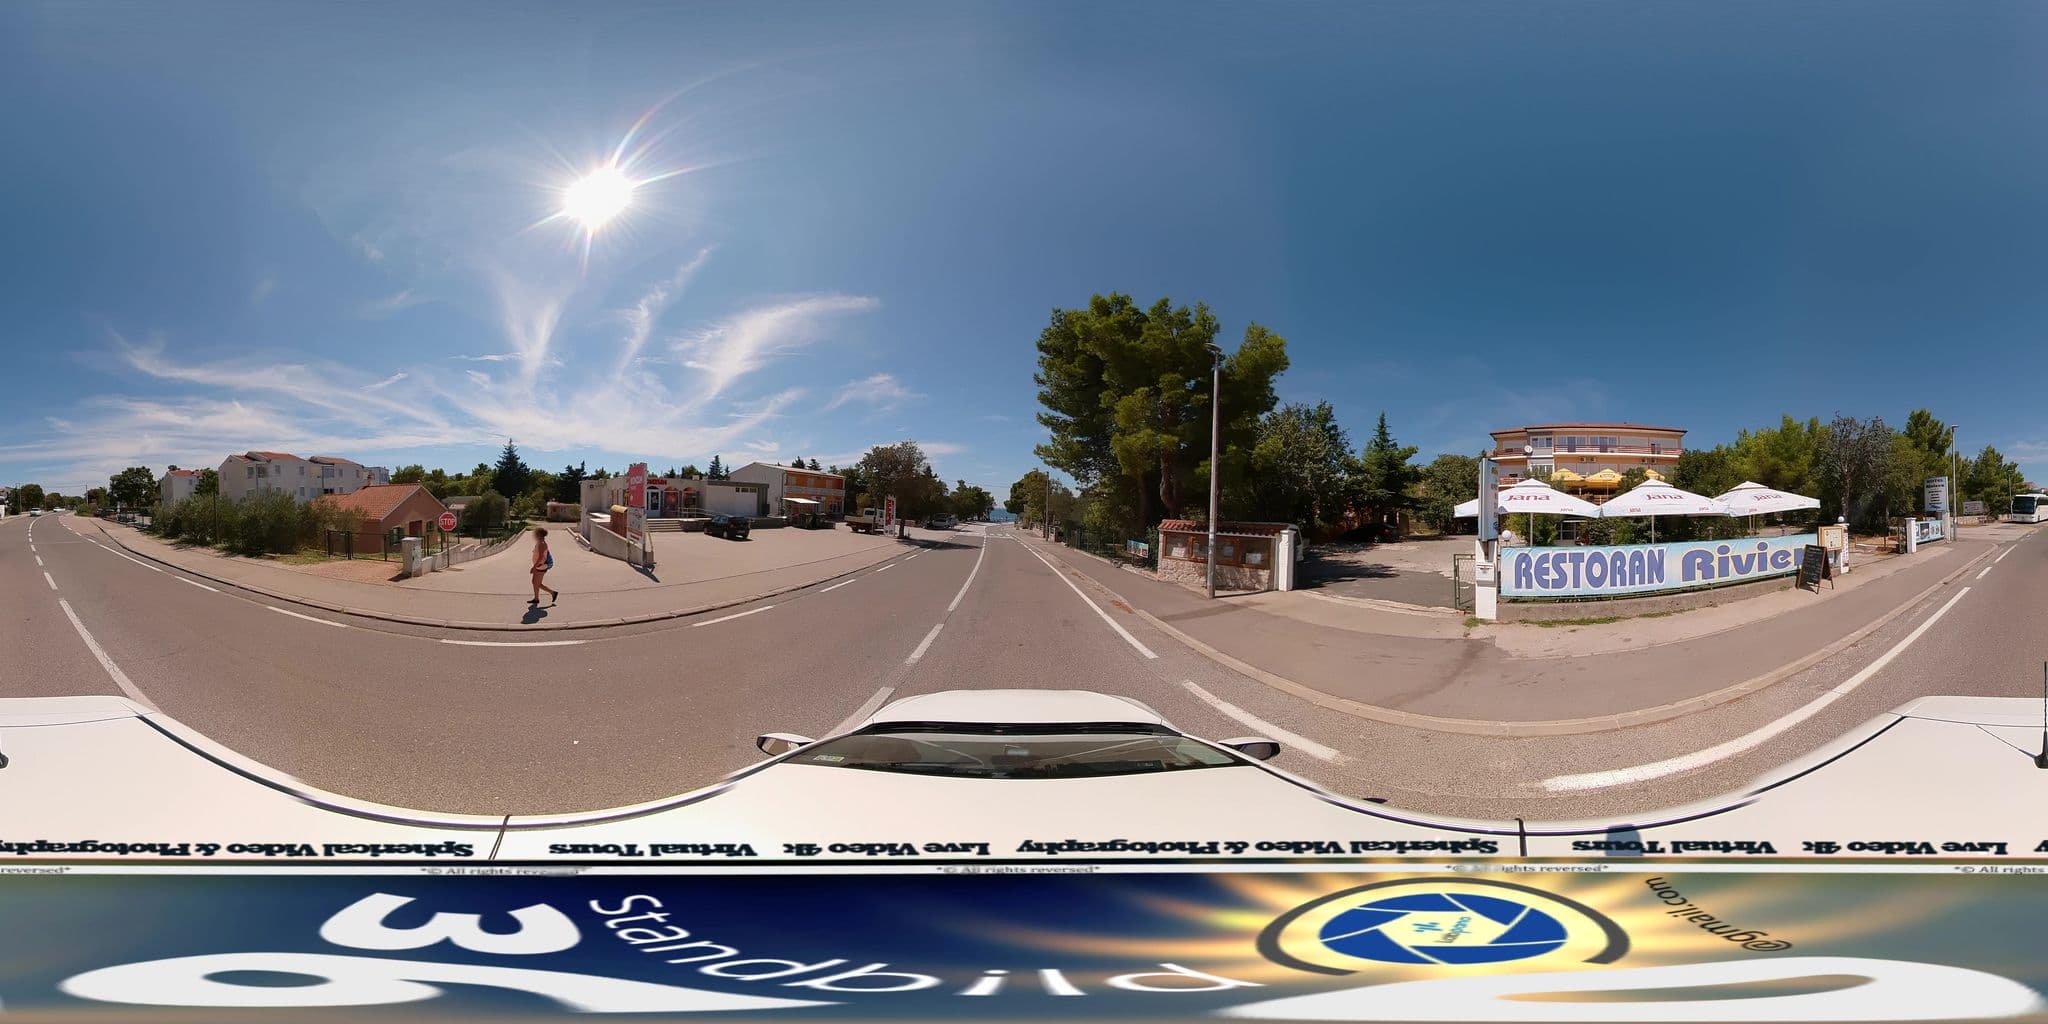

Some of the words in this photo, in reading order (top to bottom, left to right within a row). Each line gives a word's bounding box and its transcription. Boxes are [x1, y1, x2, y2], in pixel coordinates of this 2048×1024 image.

[440, 518, 455, 526] STOP
[1513, 548, 1666, 590] RESTORAN
[1681, 540, 1806, 583] Rivier
